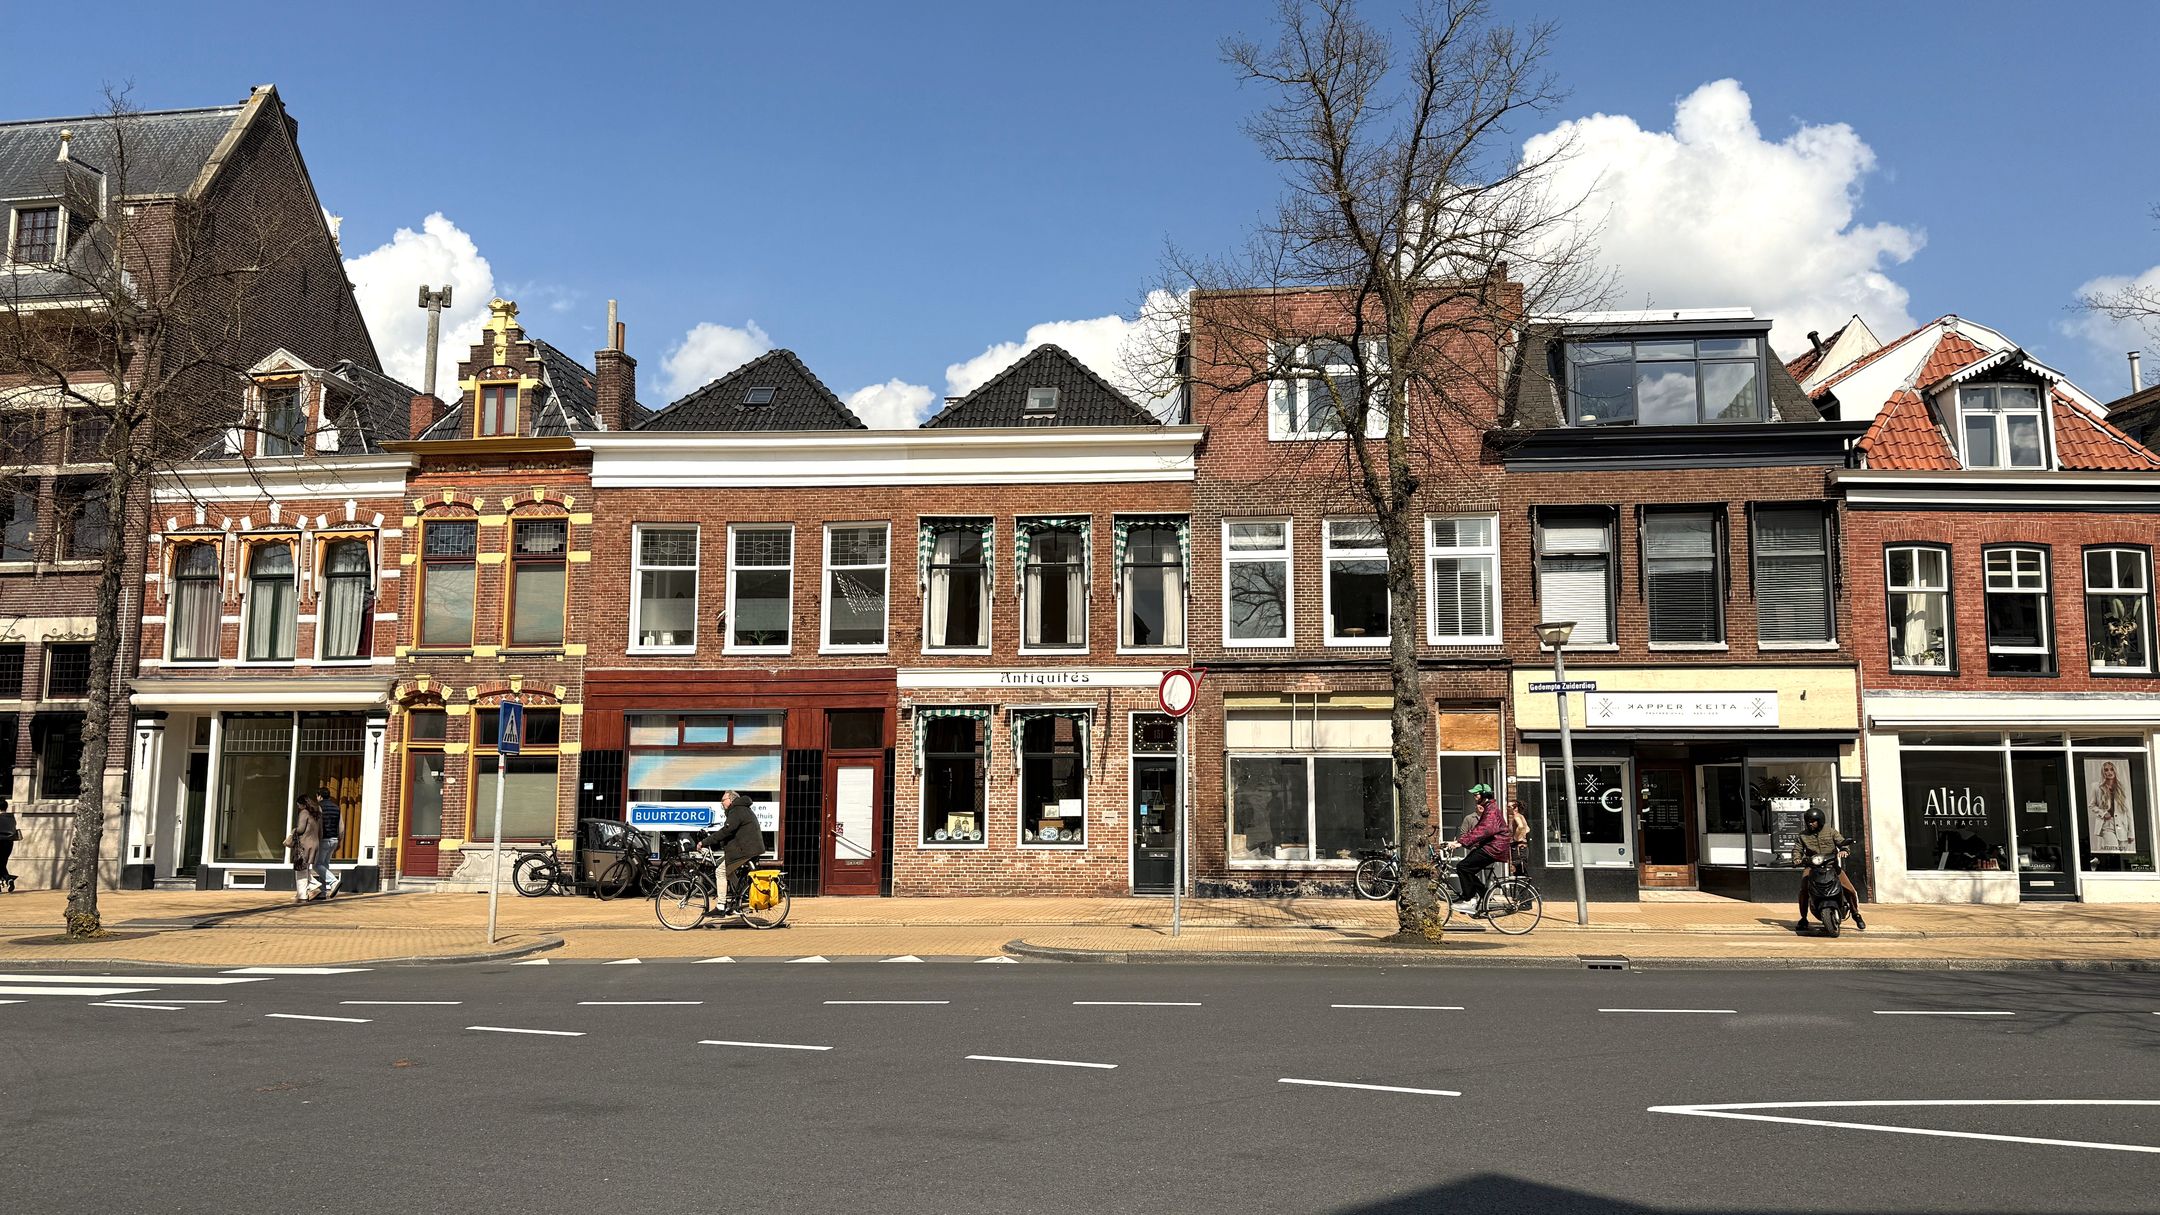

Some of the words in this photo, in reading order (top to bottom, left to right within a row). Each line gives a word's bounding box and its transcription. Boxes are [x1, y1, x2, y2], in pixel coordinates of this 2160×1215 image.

[1000, 671, 1090, 685] Antiquités
[1529, 683, 1561, 691] Gedempte
[1561, 682, 1596, 690] Zuiderdiep
[1923, 787, 1987, 816] Alida
[635, 811, 706, 821] BUURTZORG
